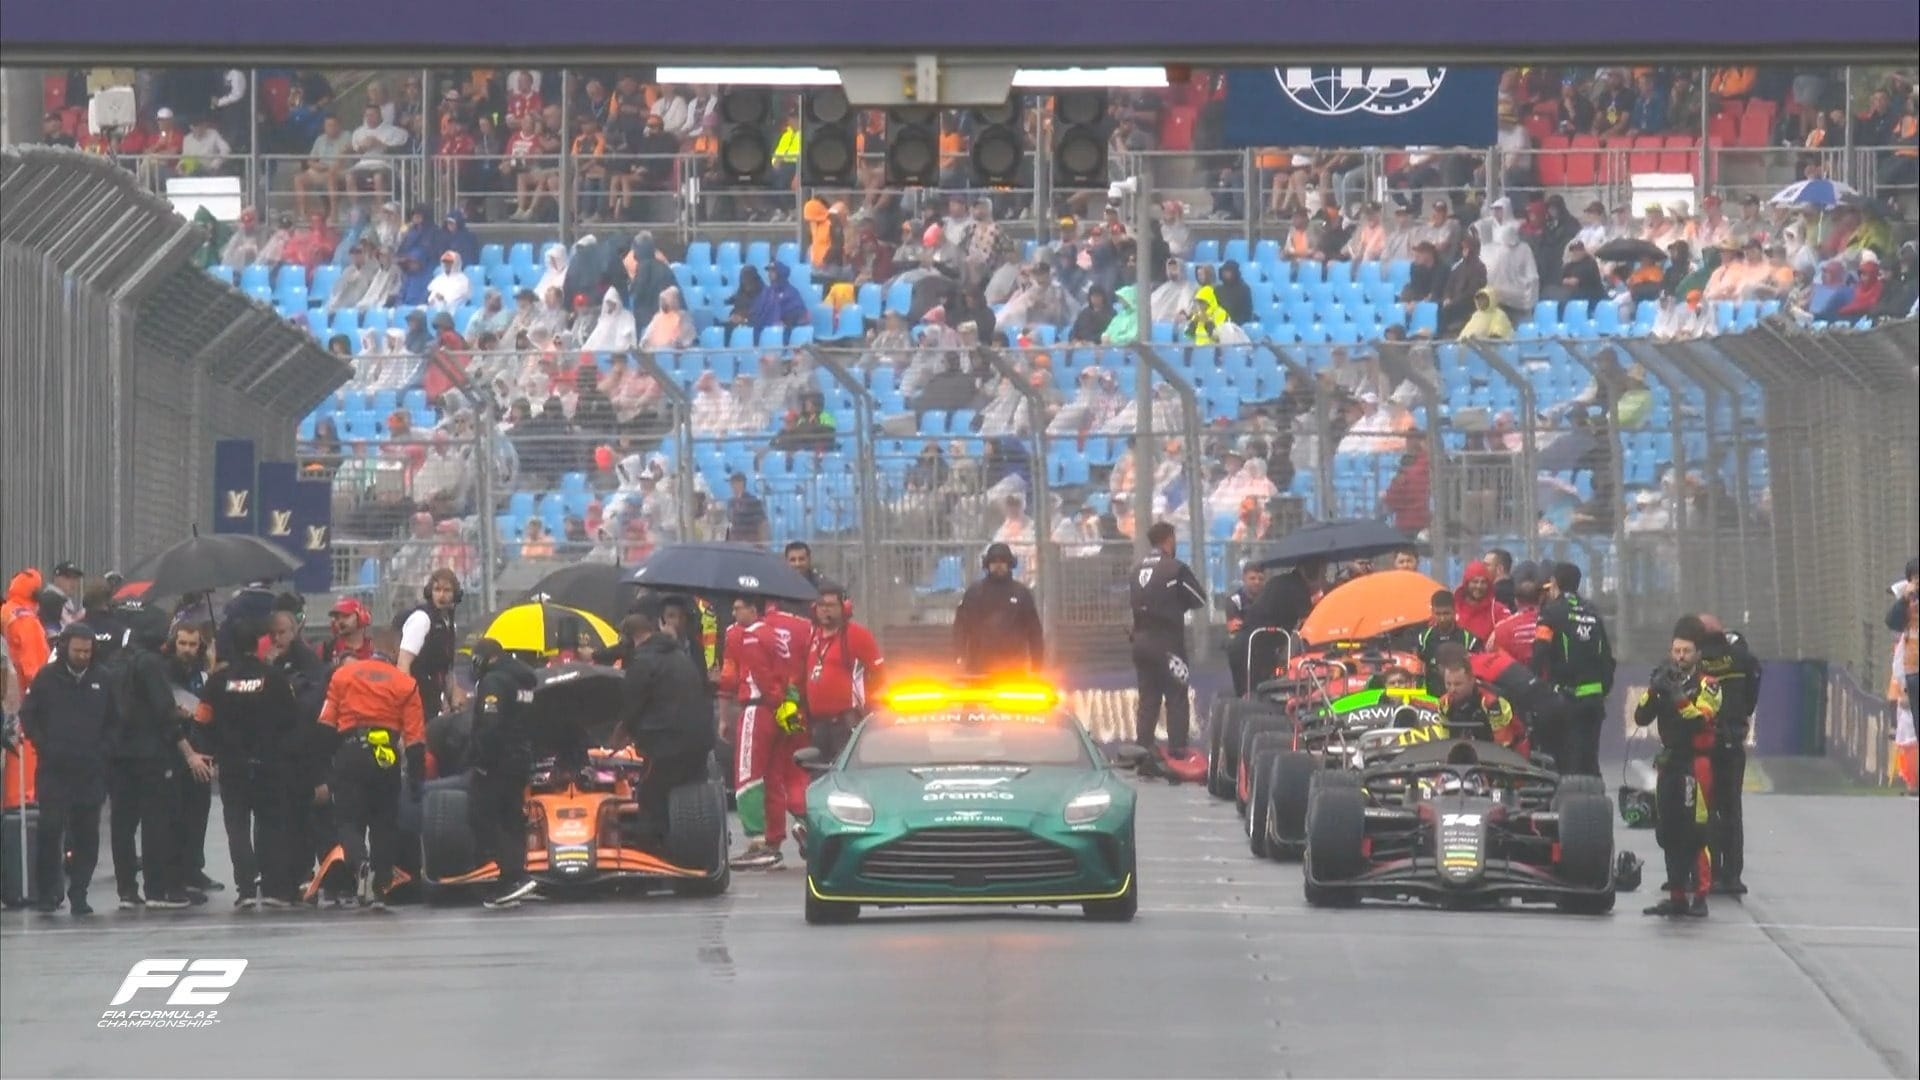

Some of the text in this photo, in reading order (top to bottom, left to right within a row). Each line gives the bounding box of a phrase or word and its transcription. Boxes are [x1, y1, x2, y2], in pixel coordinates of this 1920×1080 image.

[967, 712, 1046, 724] MARTIN
[1398, 724, 1449, 747] INV
[922, 791, 1015, 802] aramco
